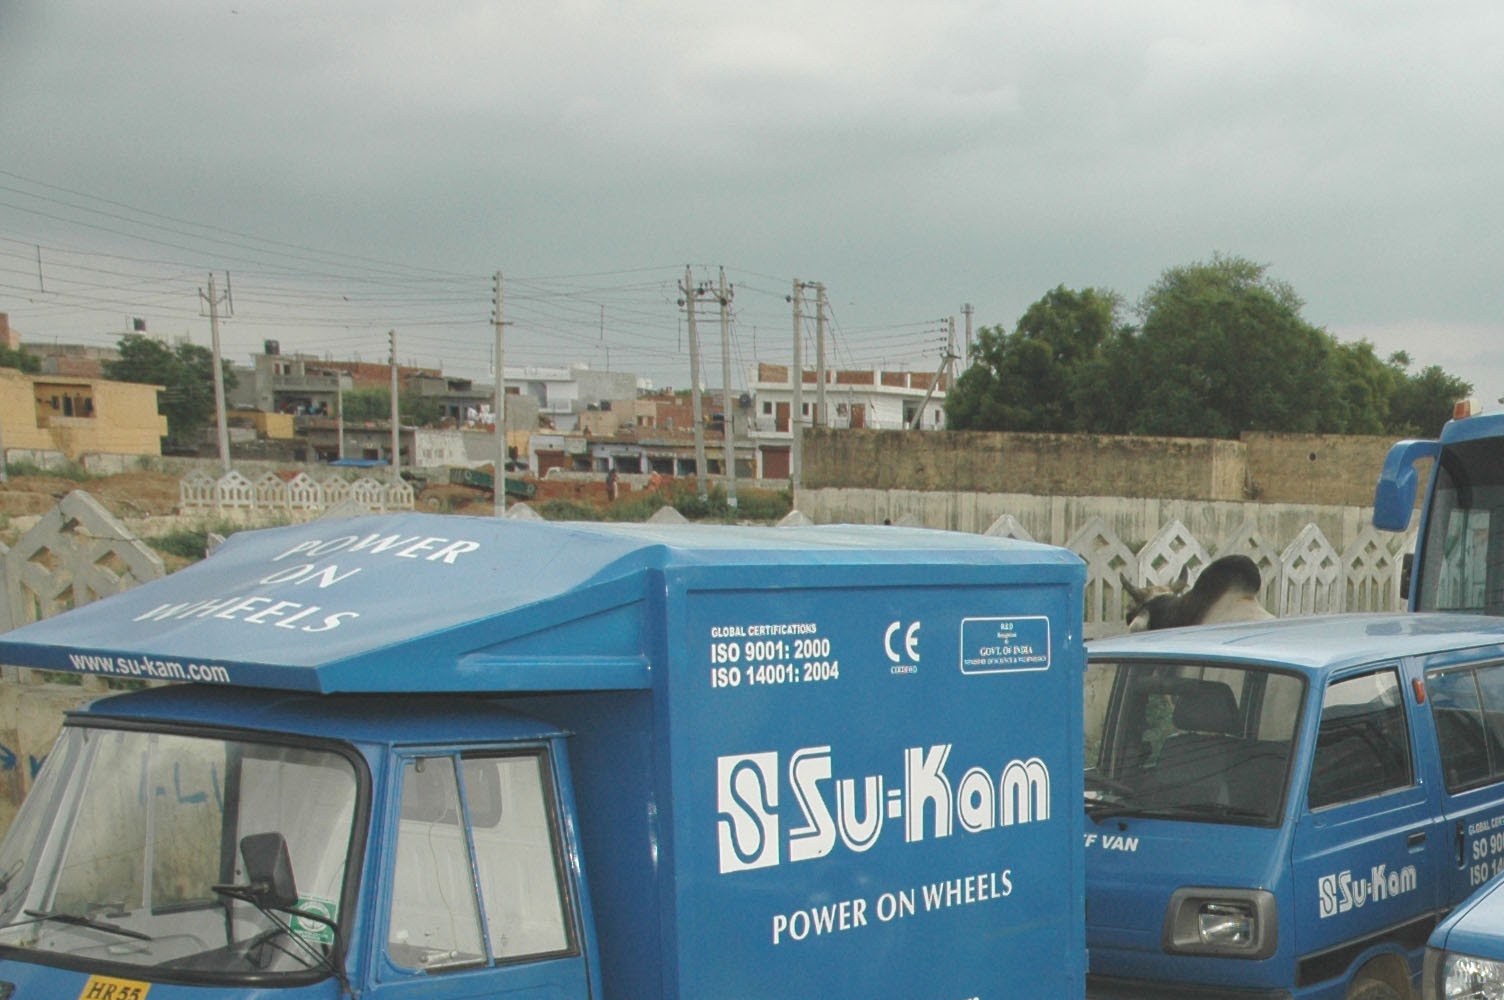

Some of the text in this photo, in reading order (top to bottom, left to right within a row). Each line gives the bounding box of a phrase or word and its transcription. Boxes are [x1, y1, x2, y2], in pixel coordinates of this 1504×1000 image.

[273, 532, 480, 565] POWER
[260, 564, 361, 588] ON
[133, 596, 360, 633] WHEELS
[711, 623, 817, 637] GLOBAL CERTIFICATIONS
[884, 621, 921, 662] CE
[711, 639, 830, 663] ISO 9001: 2000
[69, 652, 231, 683] www.su-kam.com
[712, 661, 839, 688] ISO 14001: 2004
[789, 743, 1050, 862] Su-Kam
[1468, 820, 1490, 835] GLOBAL
[1102, 836, 1139, 852] VAN
[1470, 862, 1488, 886] ISO
[1339, 864, 1417, 913] Su-Kam
[772, 869, 1013, 945] POWER ON WHEELS
[86, 981, 114, 1000] HR
